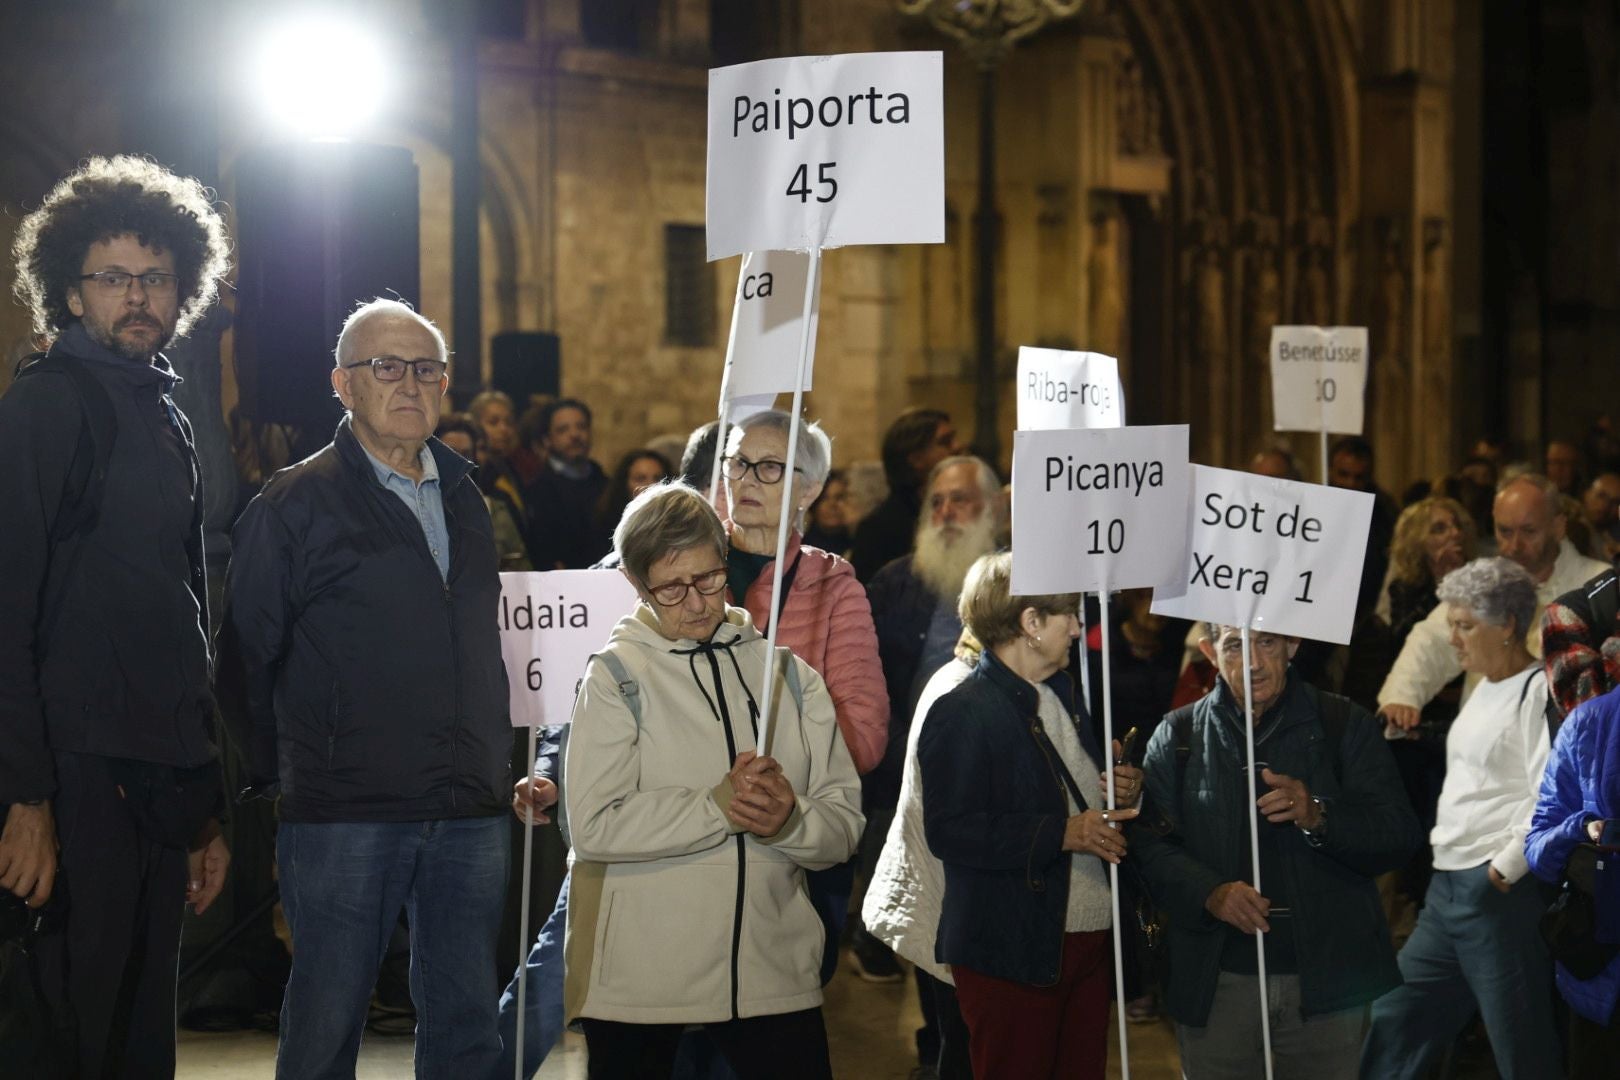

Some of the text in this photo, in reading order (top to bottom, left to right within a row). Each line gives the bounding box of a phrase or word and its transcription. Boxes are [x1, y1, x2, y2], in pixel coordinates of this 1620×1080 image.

[733, 86, 910, 140] Paiporta
[785, 161, 839, 204] 45
[1045, 455, 1164, 497] Picanya
[1086, 518, 1126, 555] 10
[1201, 492, 1323, 543] Sot de
[1189, 551, 1314, 604] Xera 1
[498, 594, 589, 631] ldaia
[526, 657, 544, 692] 6
